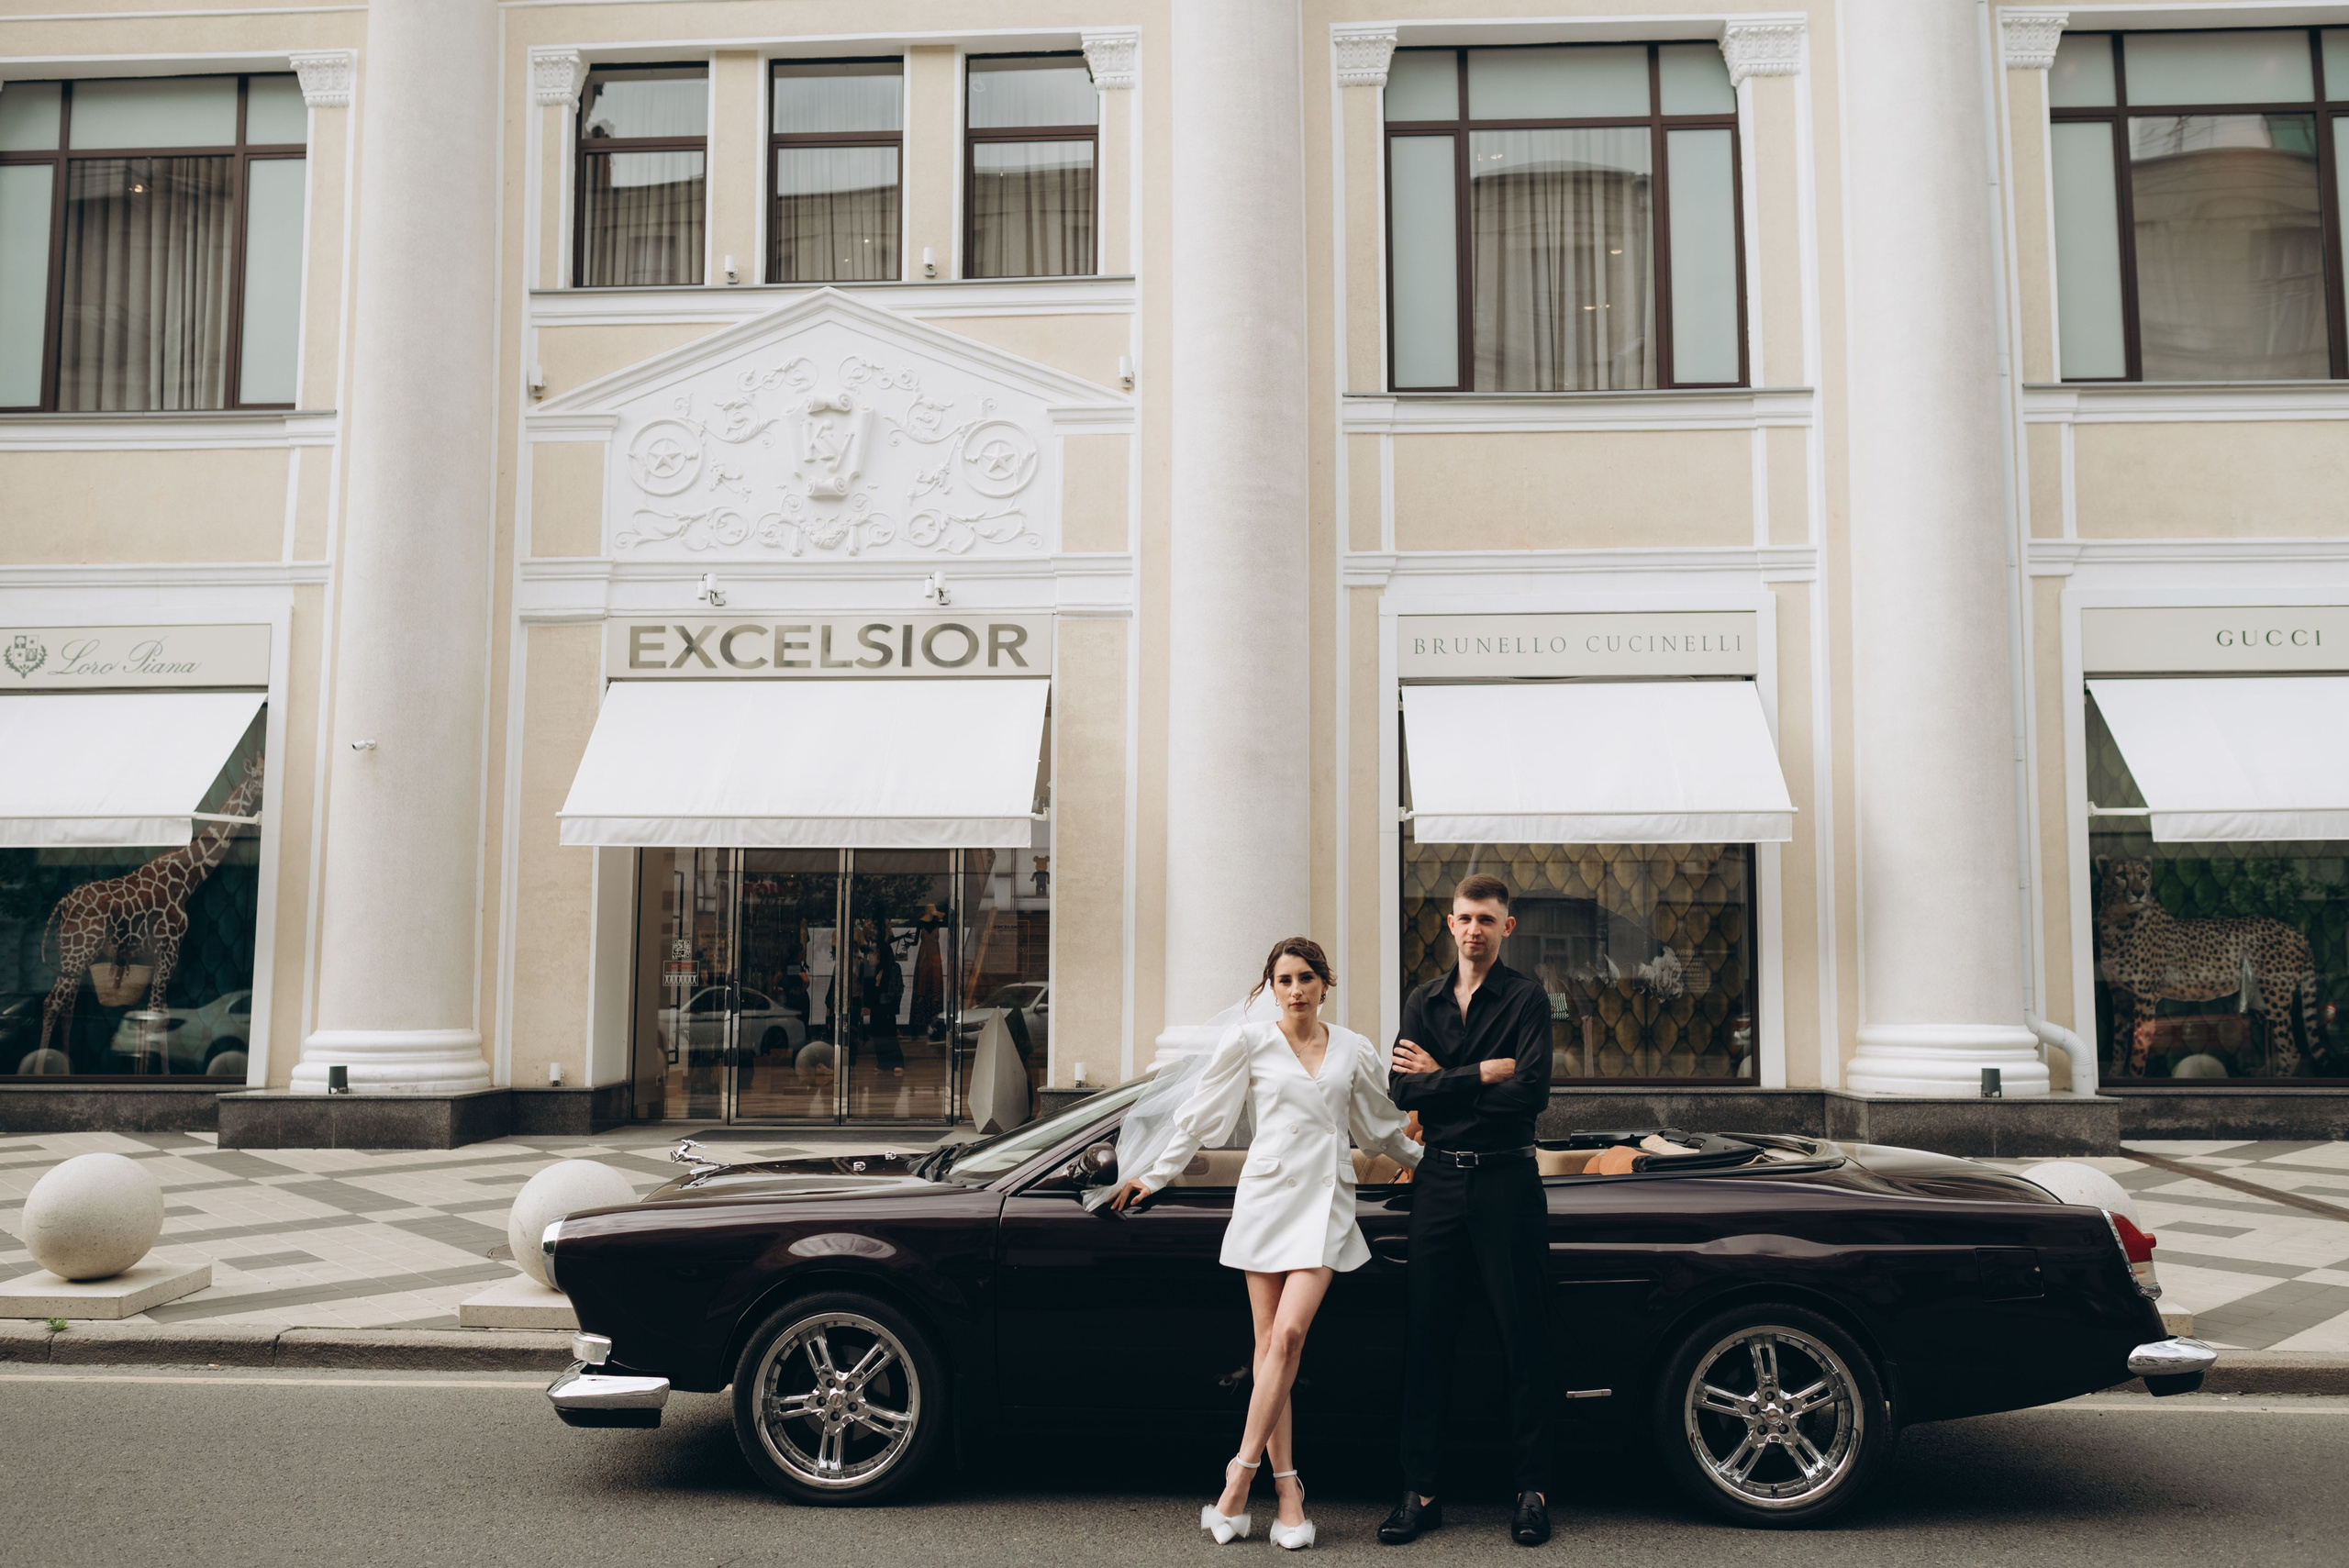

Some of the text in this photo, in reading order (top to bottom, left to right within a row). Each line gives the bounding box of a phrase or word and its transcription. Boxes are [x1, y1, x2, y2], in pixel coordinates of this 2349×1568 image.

[629, 622, 1030, 670] EXCELSIOR
[1413, 634, 1743, 655] BRUNELLO CUCINELLI
[2216, 628, 2321, 648] GUCCI
[47, 635, 202, 675] Loro Piana
